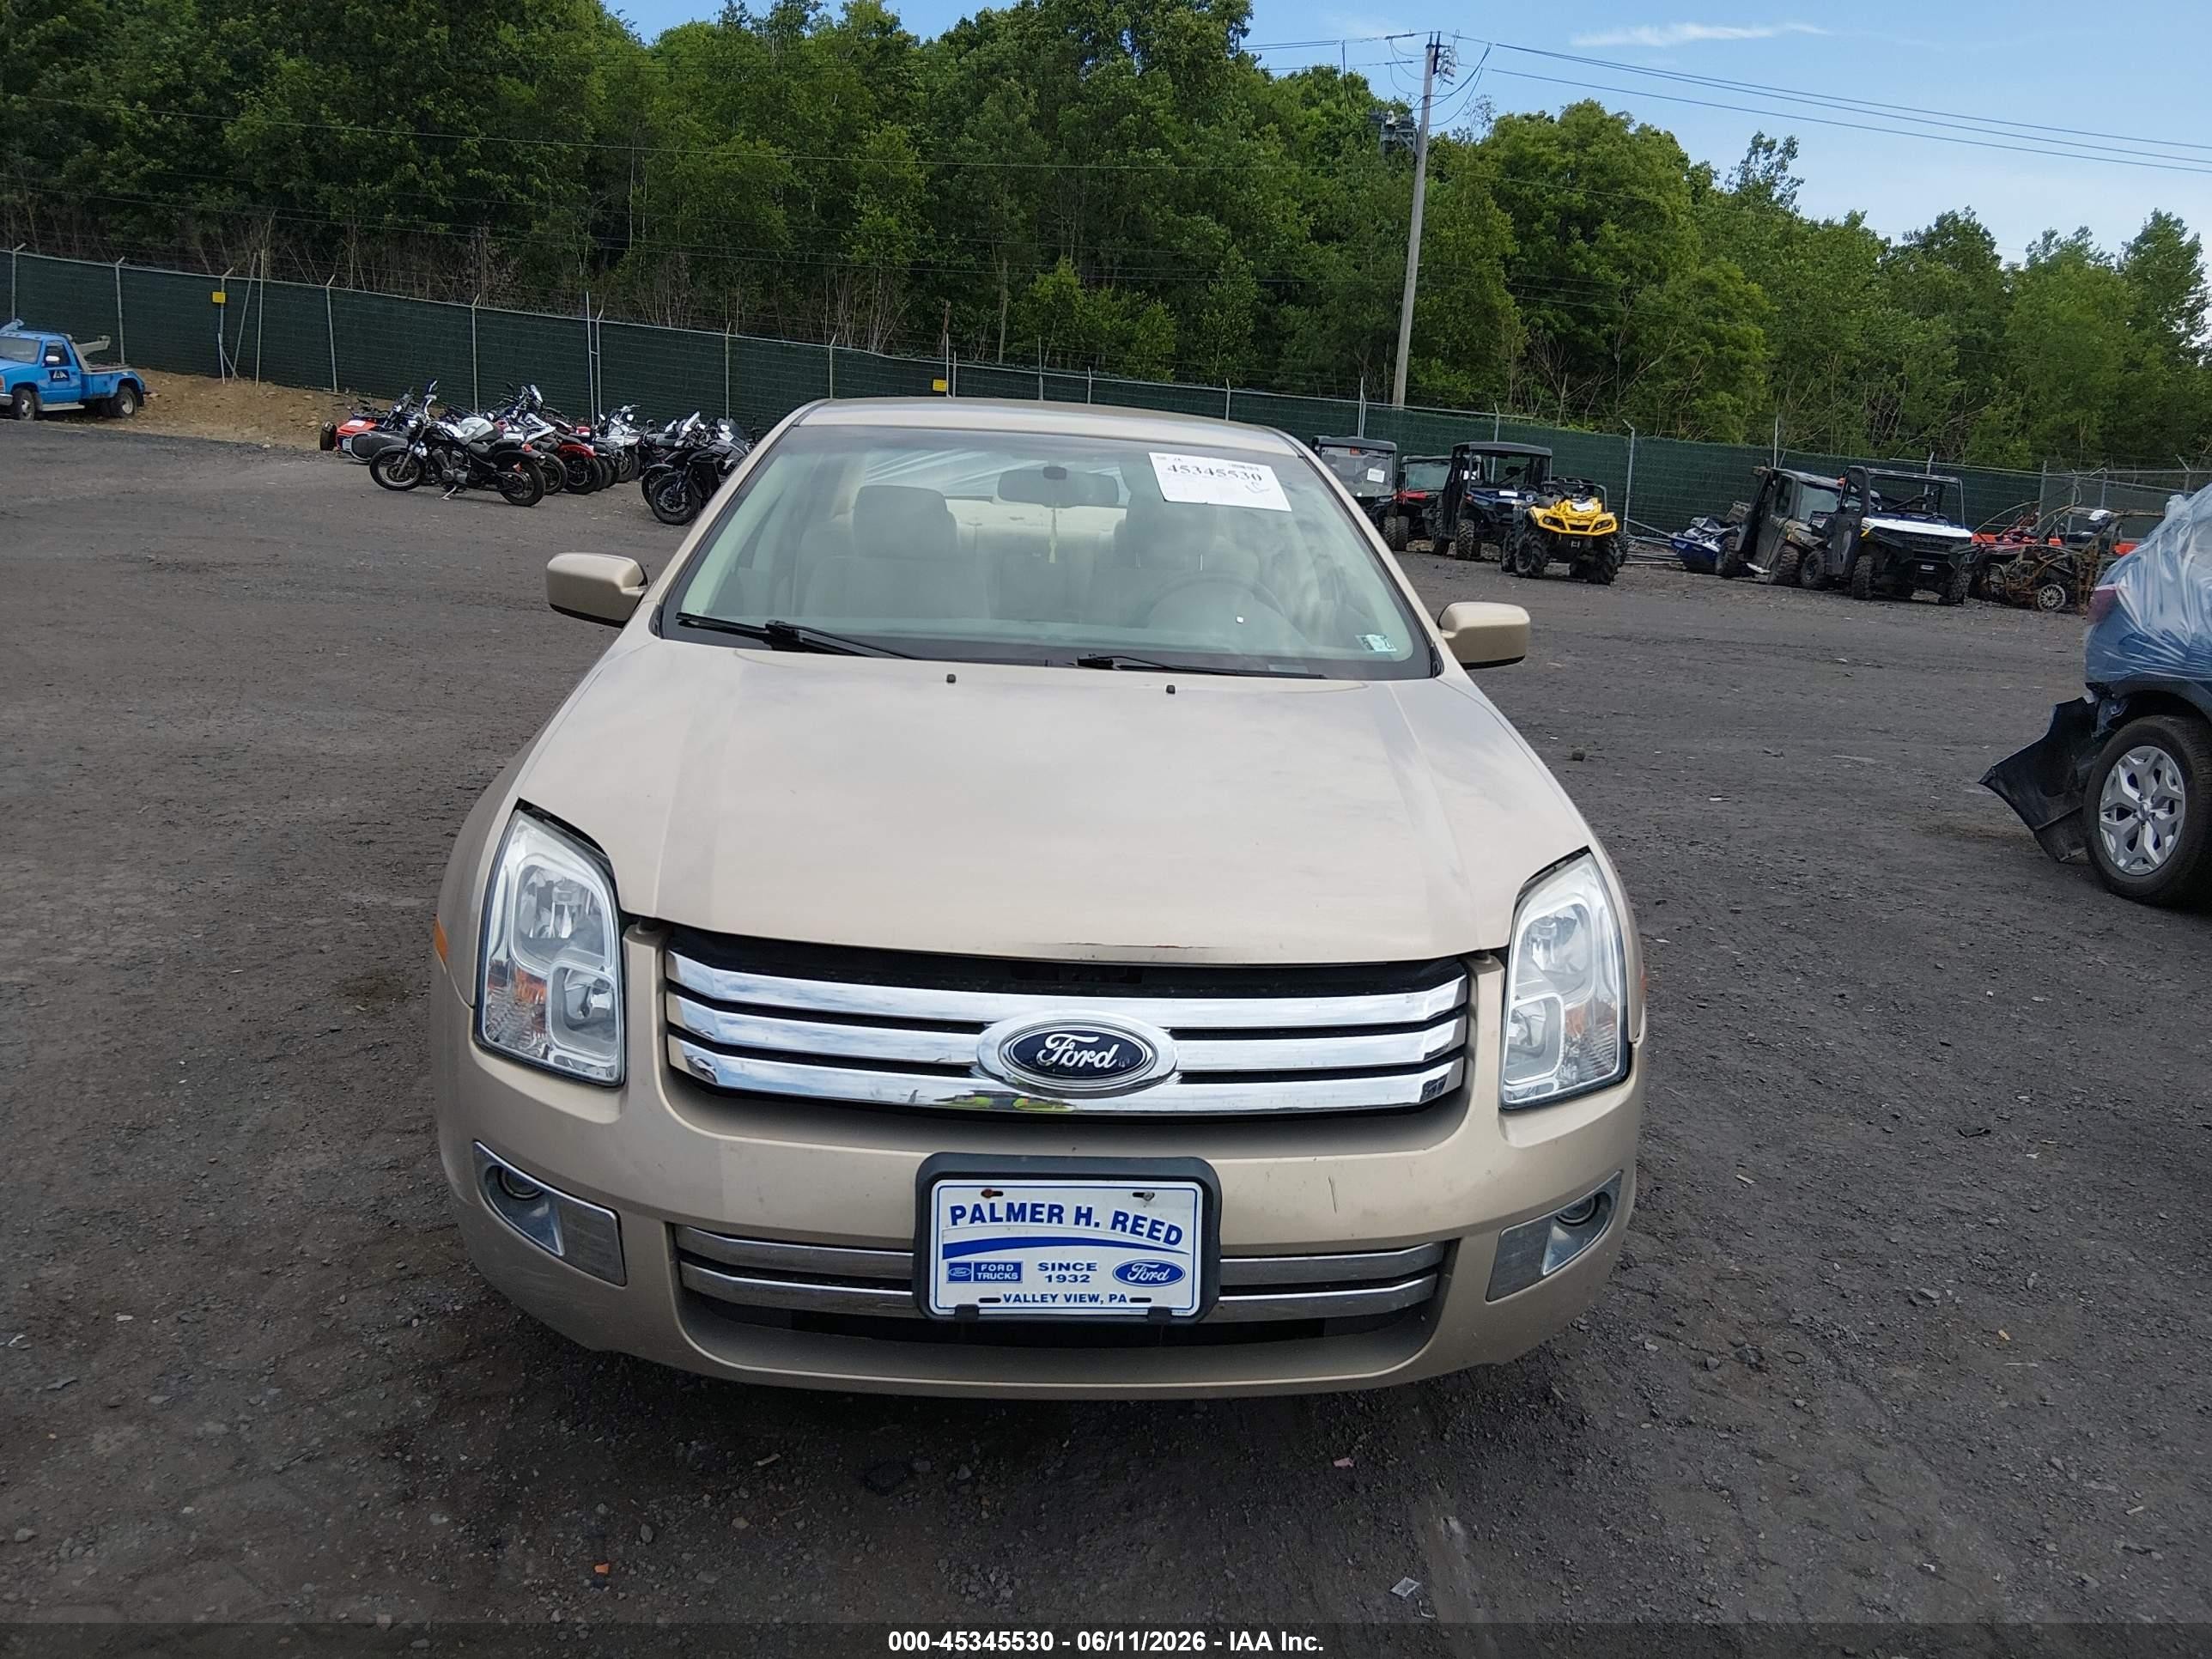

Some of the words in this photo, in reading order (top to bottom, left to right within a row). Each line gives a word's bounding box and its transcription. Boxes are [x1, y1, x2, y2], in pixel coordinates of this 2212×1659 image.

[1168, 465, 1262, 481] 45345530
[1036, 1033, 1120, 1068] Ford
[950, 1201, 1065, 1226] PALMER
[1073, 1206, 1101, 1228] H.
[1110, 1210, 1183, 1246] REED
[981, 1263, 1014, 1272] FORD
[1037, 1261, 1097, 1272] SINCE
[1127, 1262, 1170, 1281] Ford
[976, 1272, 1018, 1280] TRUCKS
[1044, 1273, 1091, 1284] 1932
[1003, 1293, 1058, 1304] VALLEY
[1064, 1293, 1104, 1305] VIEW,
[1109, 1293, 1127, 1304] PA
